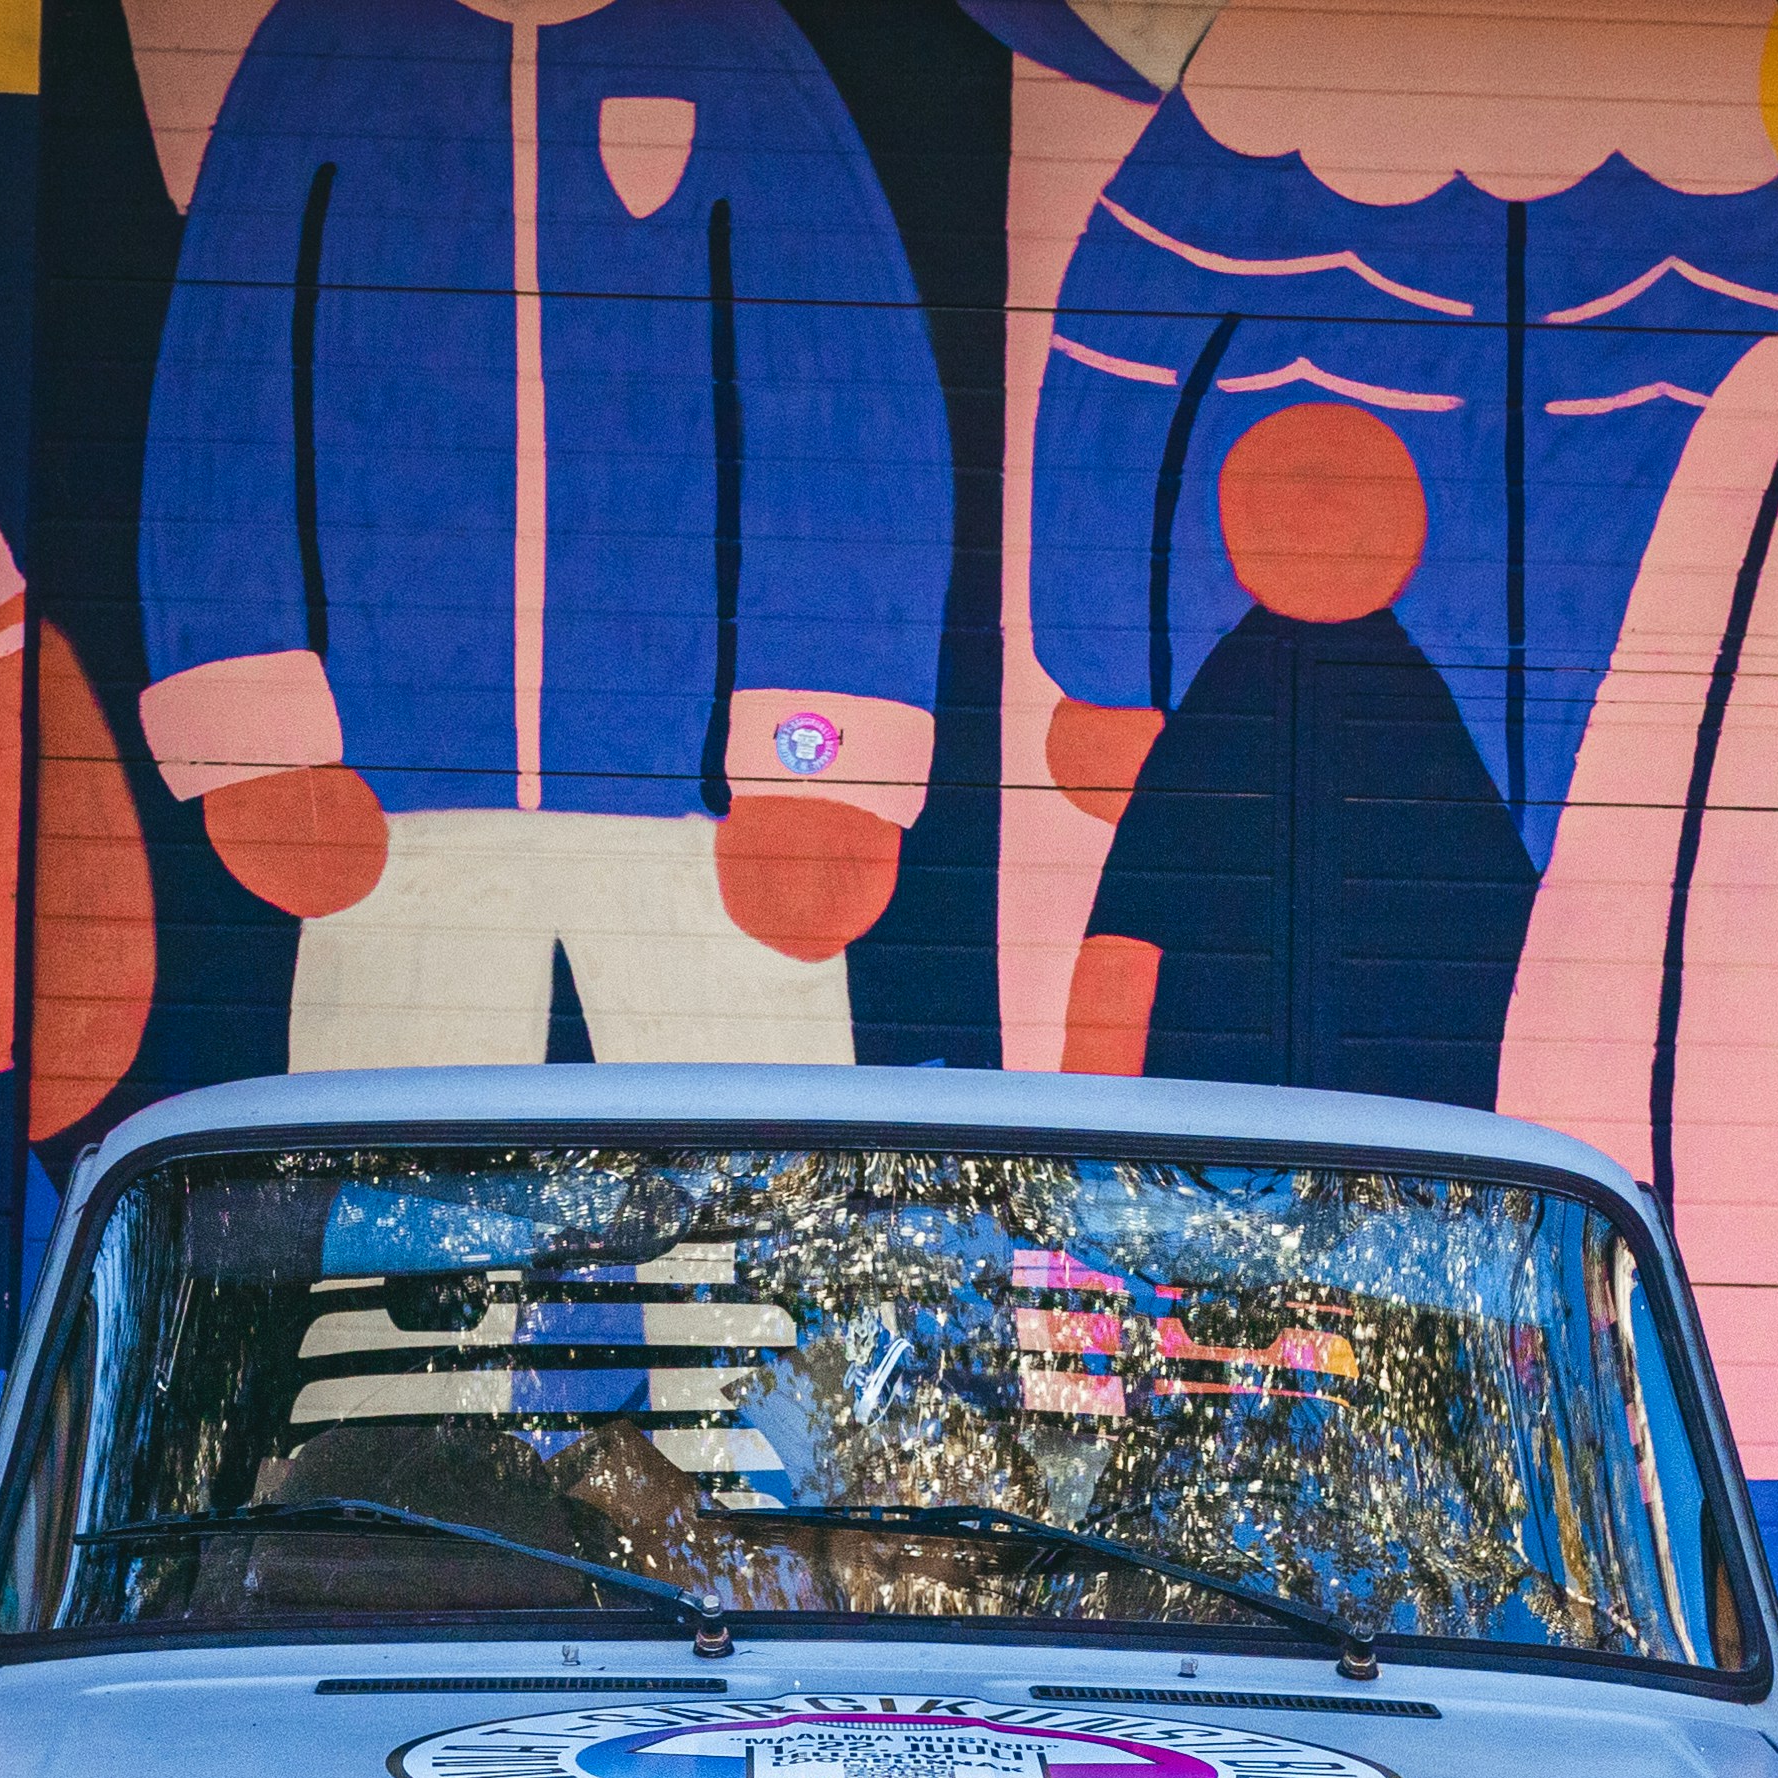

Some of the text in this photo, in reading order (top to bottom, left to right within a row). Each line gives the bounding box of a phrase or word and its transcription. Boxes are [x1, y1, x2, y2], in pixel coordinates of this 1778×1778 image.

[478, 1697, 1304, 1753] T-SÄRGIKUNSTI
[771, 1751, 954, 1761] TELLISKIVI
[903, 1743, 1023, 1760] JUULI
[772, 1757, 1024, 1772] LOOMELINNAK
